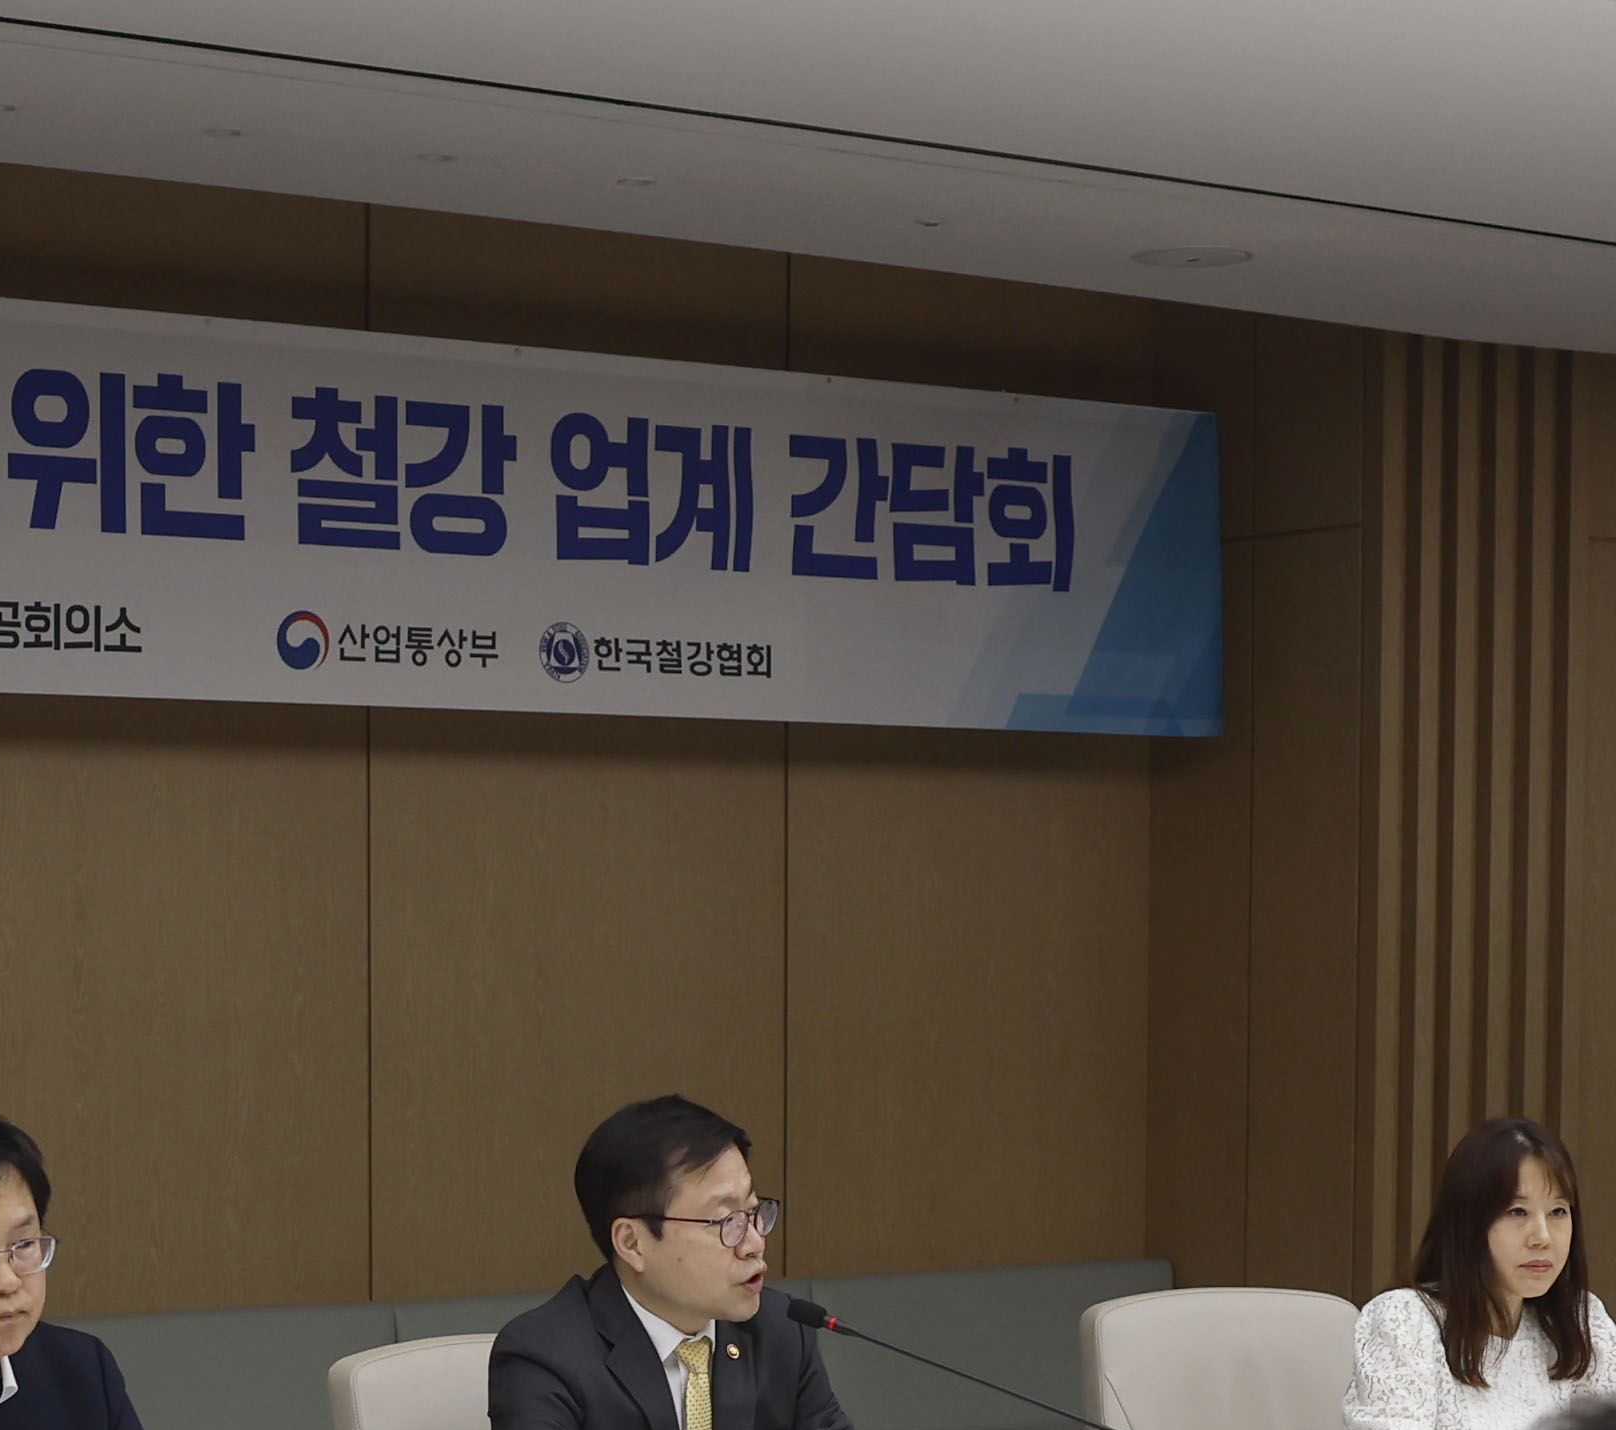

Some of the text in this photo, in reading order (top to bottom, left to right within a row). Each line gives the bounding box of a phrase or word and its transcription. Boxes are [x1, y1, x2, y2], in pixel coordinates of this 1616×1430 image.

[9, 370, 255, 540] 위한
[292, 389, 516, 555] 철강
[552, 413, 753, 572] 업계
[791, 436, 1074, 591] 간담회
[337, 623, 499, 669] 산업통상부
[593, 636, 772, 679] 한국철강협회
